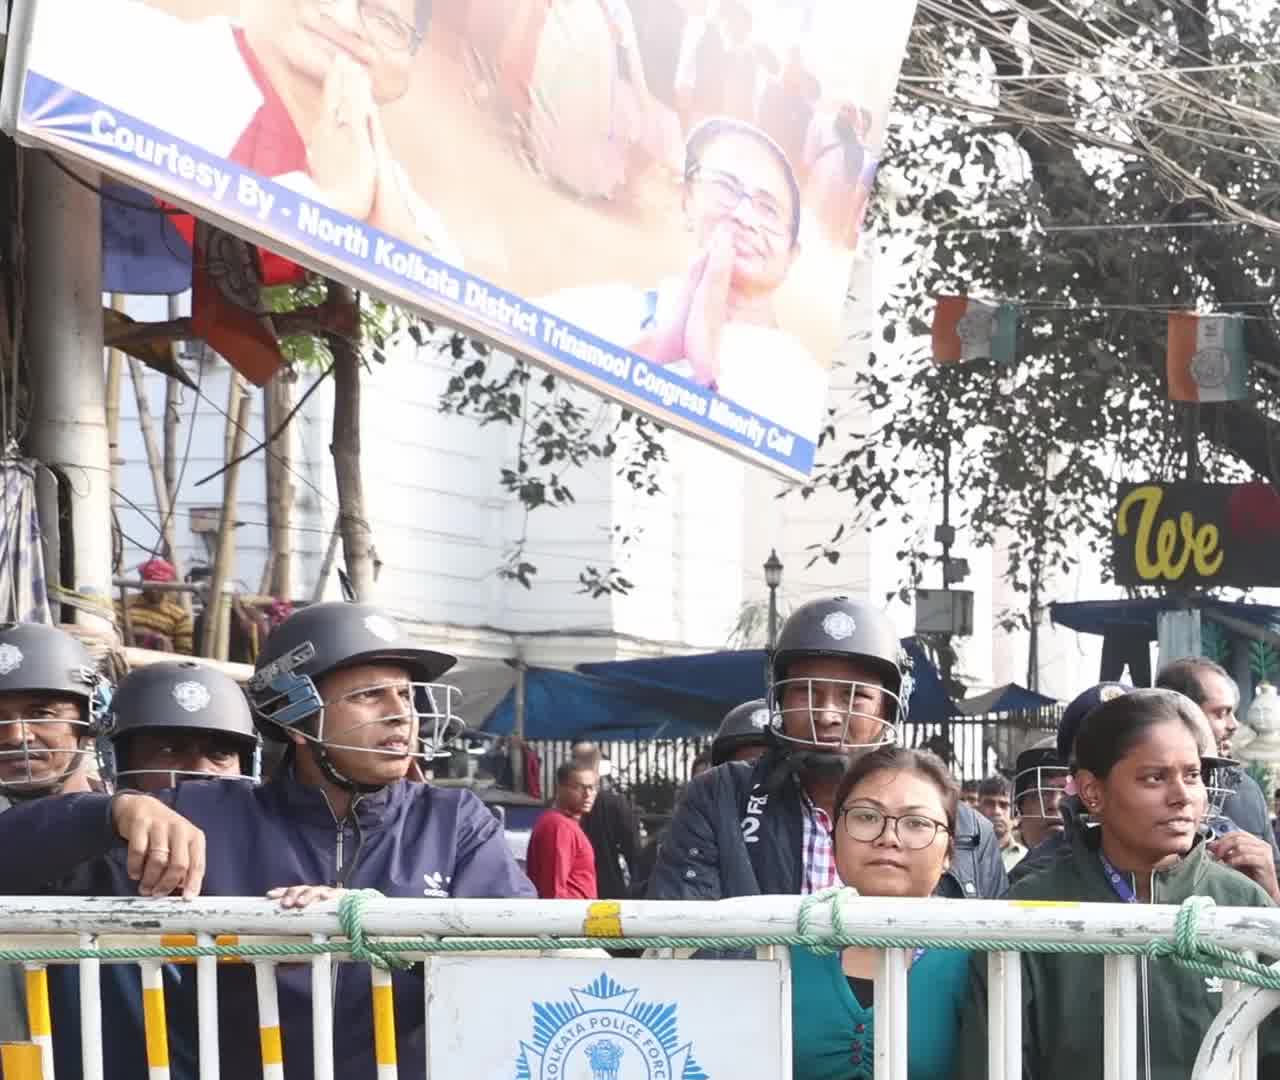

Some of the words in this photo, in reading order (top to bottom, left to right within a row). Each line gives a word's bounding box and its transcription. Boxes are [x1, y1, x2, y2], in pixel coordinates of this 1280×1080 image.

[90, 110, 231, 200] Courtesy
[238, 177, 277, 221] By
[282, 206, 292, 217] -
[297, 203, 369, 259] North
[374, 236, 461, 301] Kolkata
[466, 280, 539, 337] District
[542, 318, 632, 382] Trinamool
[631, 361, 707, 417] Congress
[708, 397, 766, 448] Minority
[764, 428, 796, 456] Cell
[1117, 486, 1224, 580] We
[589, 1016, 643, 1040] POLICE
